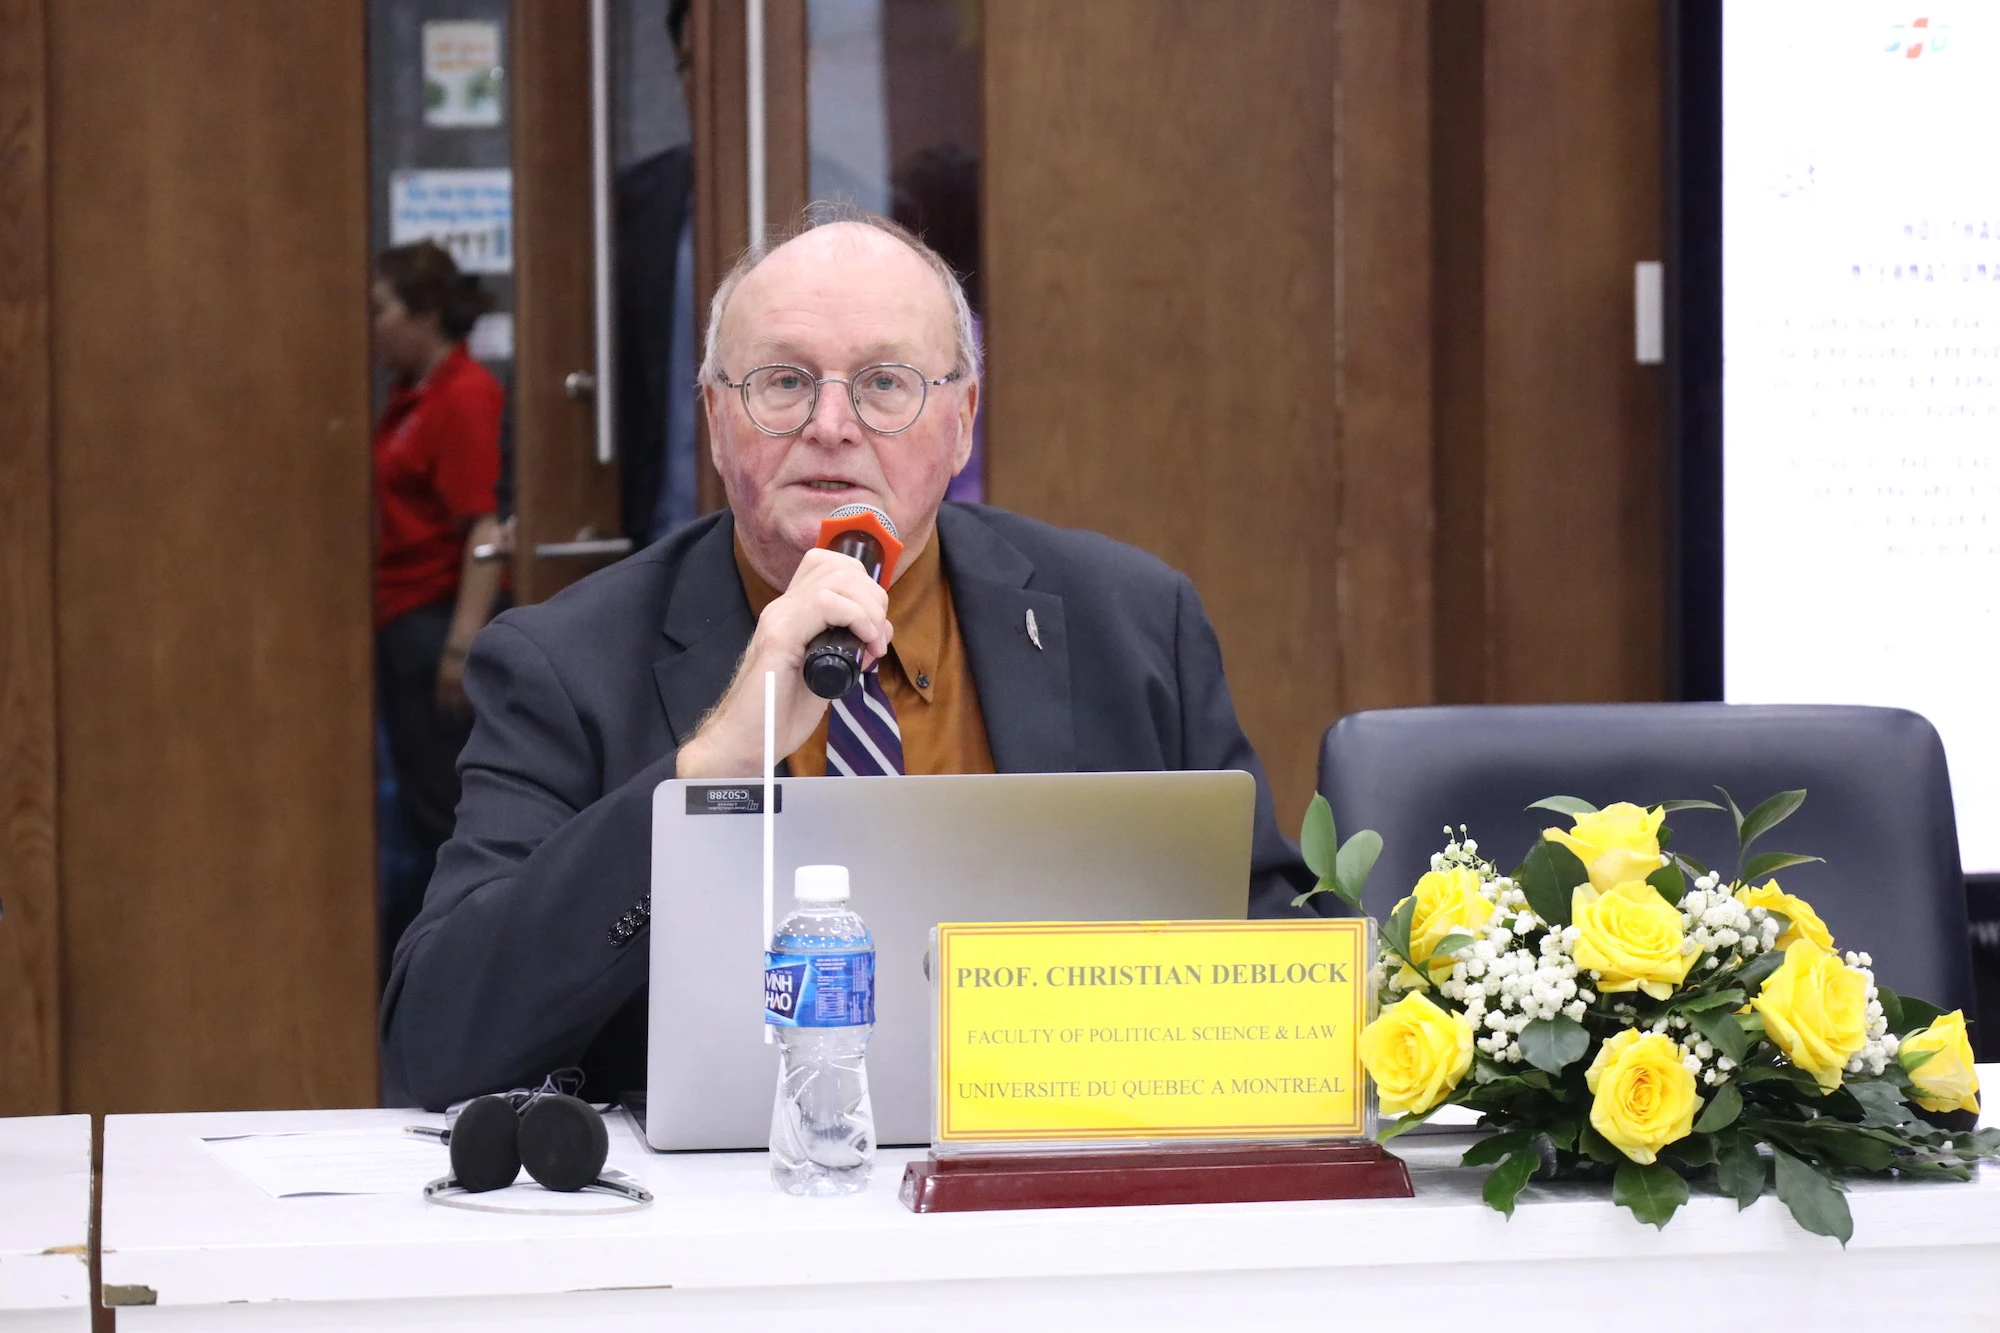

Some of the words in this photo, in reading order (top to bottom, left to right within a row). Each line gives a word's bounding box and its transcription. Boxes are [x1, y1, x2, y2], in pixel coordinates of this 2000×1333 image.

[709, 790, 748, 800] C50288
[957, 967, 1038, 988] PROF.
[1046, 965, 1202, 987] CHRISTIAN
[1212, 962, 1348, 985] DEBLOCK
[967, 1029, 1055, 1044] FACULTY
[1060, 1029, 1083, 1043] OF
[1089, 1027, 1187, 1043] POLITICAL
[1191, 1026, 1270, 1041] SCIENCE
[1275, 1026, 1289, 1040] &
[1294, 1025, 1337, 1040] LAW
[958, 1082, 1081, 1099] UNIVERSITE
[1087, 1081, 1116, 1097] DU
[1122, 1080, 1206, 1099] QUEBEC
[1211, 1080, 1225, 1095] A
[1231, 1077, 1346, 1095] MONTREAL
